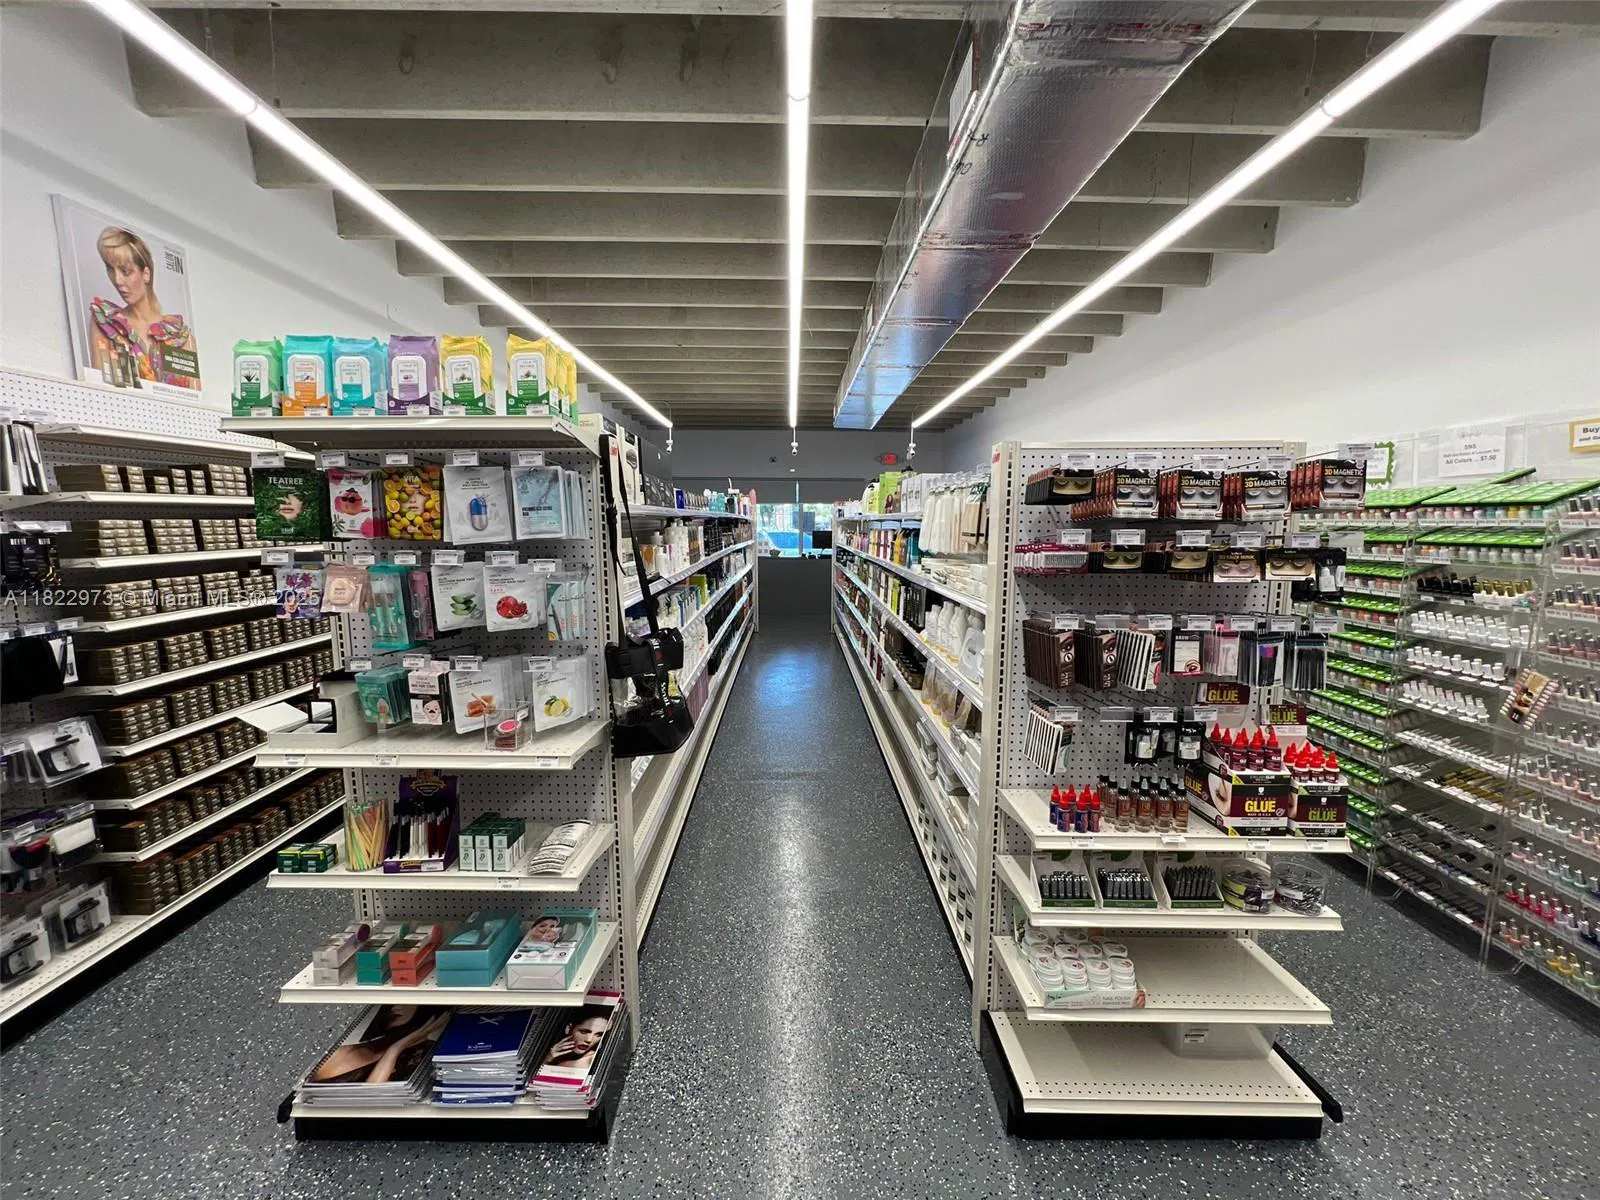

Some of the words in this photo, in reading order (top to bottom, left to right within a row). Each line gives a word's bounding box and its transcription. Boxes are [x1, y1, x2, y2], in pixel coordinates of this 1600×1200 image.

[1333, 468, 1364, 476] MAGNETIC
[268, 476, 304, 485] TEATREE
[1254, 479, 1287, 487] MAGNETIC
[1208, 690, 1239, 701] GLUE
[1270, 712, 1297, 722] GLUE
[1185, 776, 1203, 794] GLUE
[1244, 800, 1276, 812] GLUE
[1308, 811, 1338, 821] GLUE
